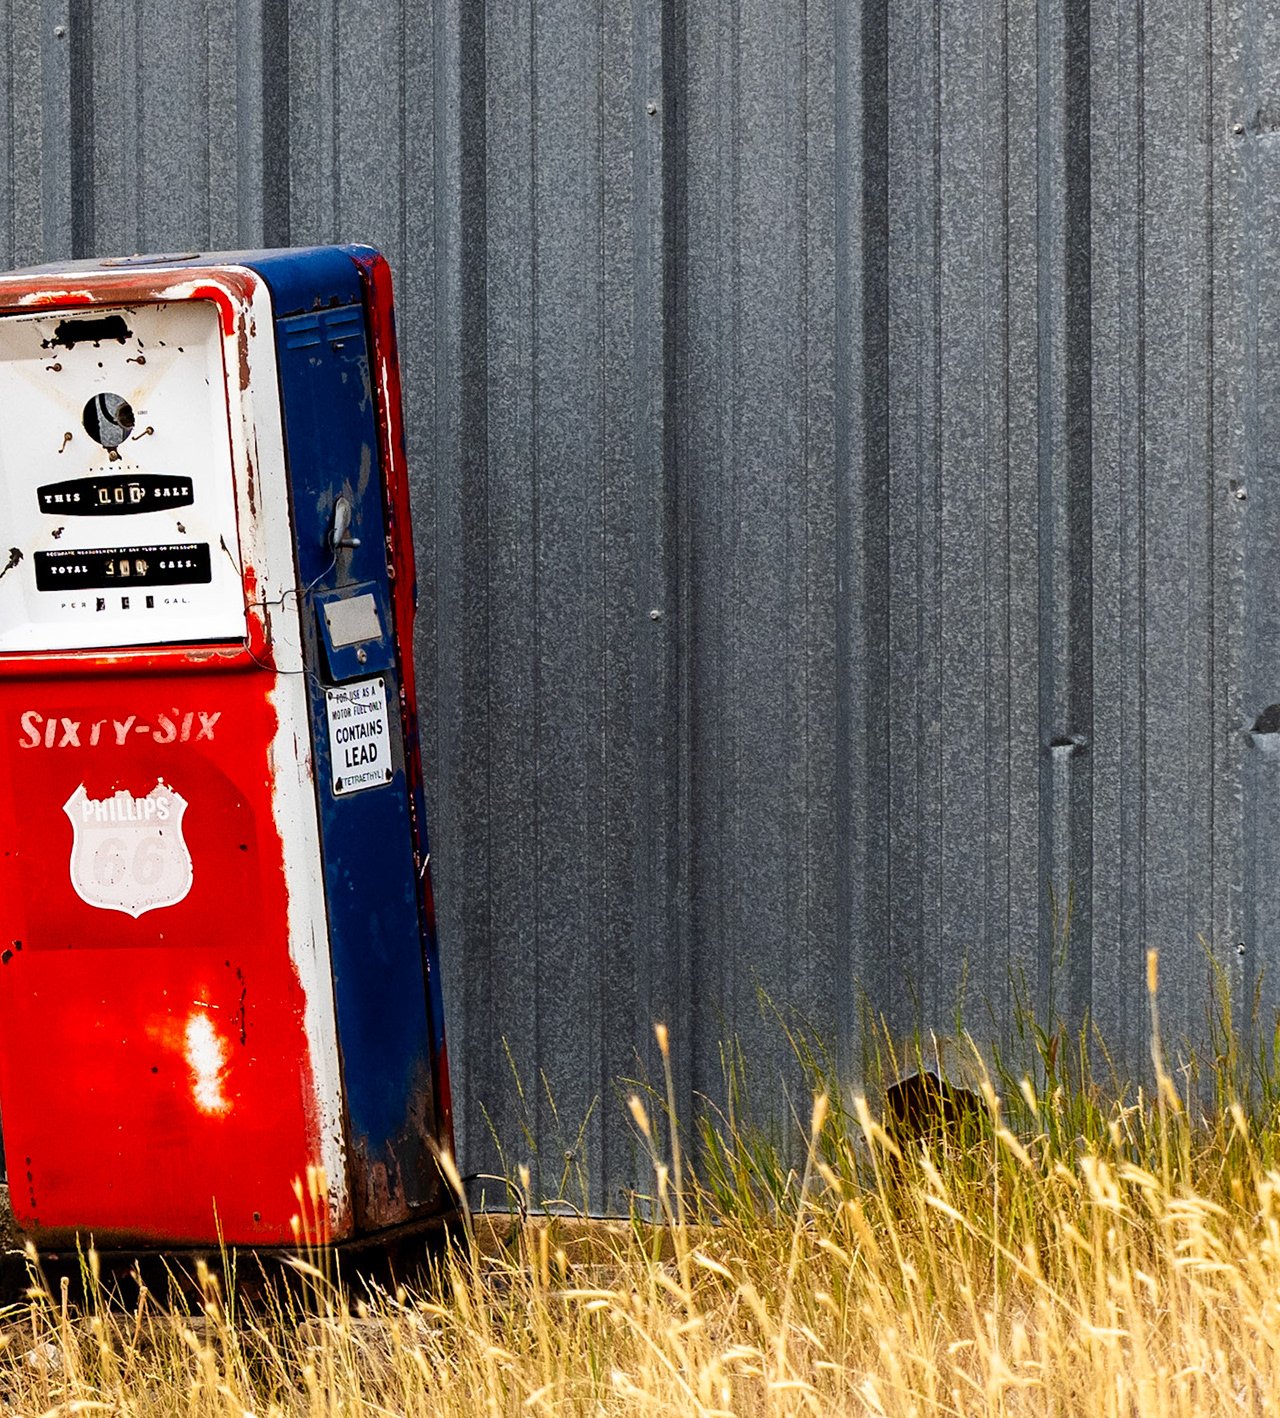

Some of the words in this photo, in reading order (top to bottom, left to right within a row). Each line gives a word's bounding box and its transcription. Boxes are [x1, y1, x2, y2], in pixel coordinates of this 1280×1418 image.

[44, 493, 81, 504] THIS
[153, 487, 189, 498] SALE
[50, 565, 88, 575] TOTAL
[159, 560, 198, 569] GALS.
[336, 692, 348, 704] FOR
[348, 688, 360, 701] USE
[362, 687, 370, 698] AS
[371, 685, 376, 696] A
[332, 707, 352, 721] MOTOR
[353, 704, 368, 716] FUEL
[368, 700, 383, 713] ONLY
[335, 718, 383, 744] CONTAINS
[345, 742, 378, 768] LEAD
[81, 796, 171, 823] PHILLIPS
[93, 837, 167, 887] 66
